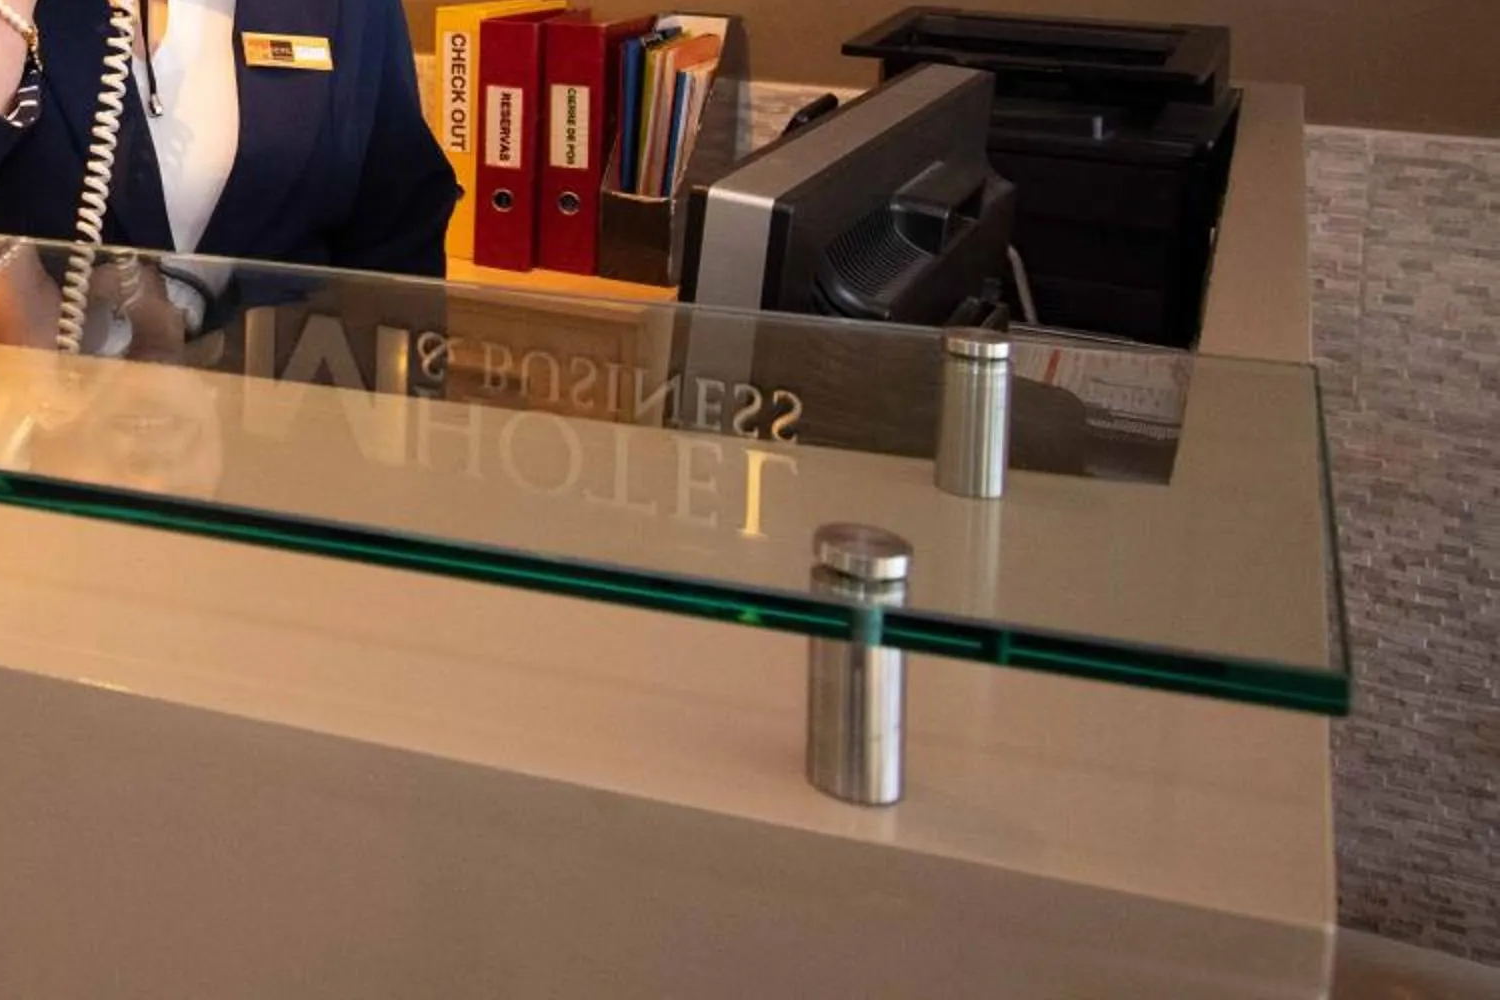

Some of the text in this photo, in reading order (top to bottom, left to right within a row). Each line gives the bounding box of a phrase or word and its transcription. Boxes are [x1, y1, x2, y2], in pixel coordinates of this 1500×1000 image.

[451, 34, 467, 151] CHECK OUT
[500, 91, 512, 161] RESERVAS
